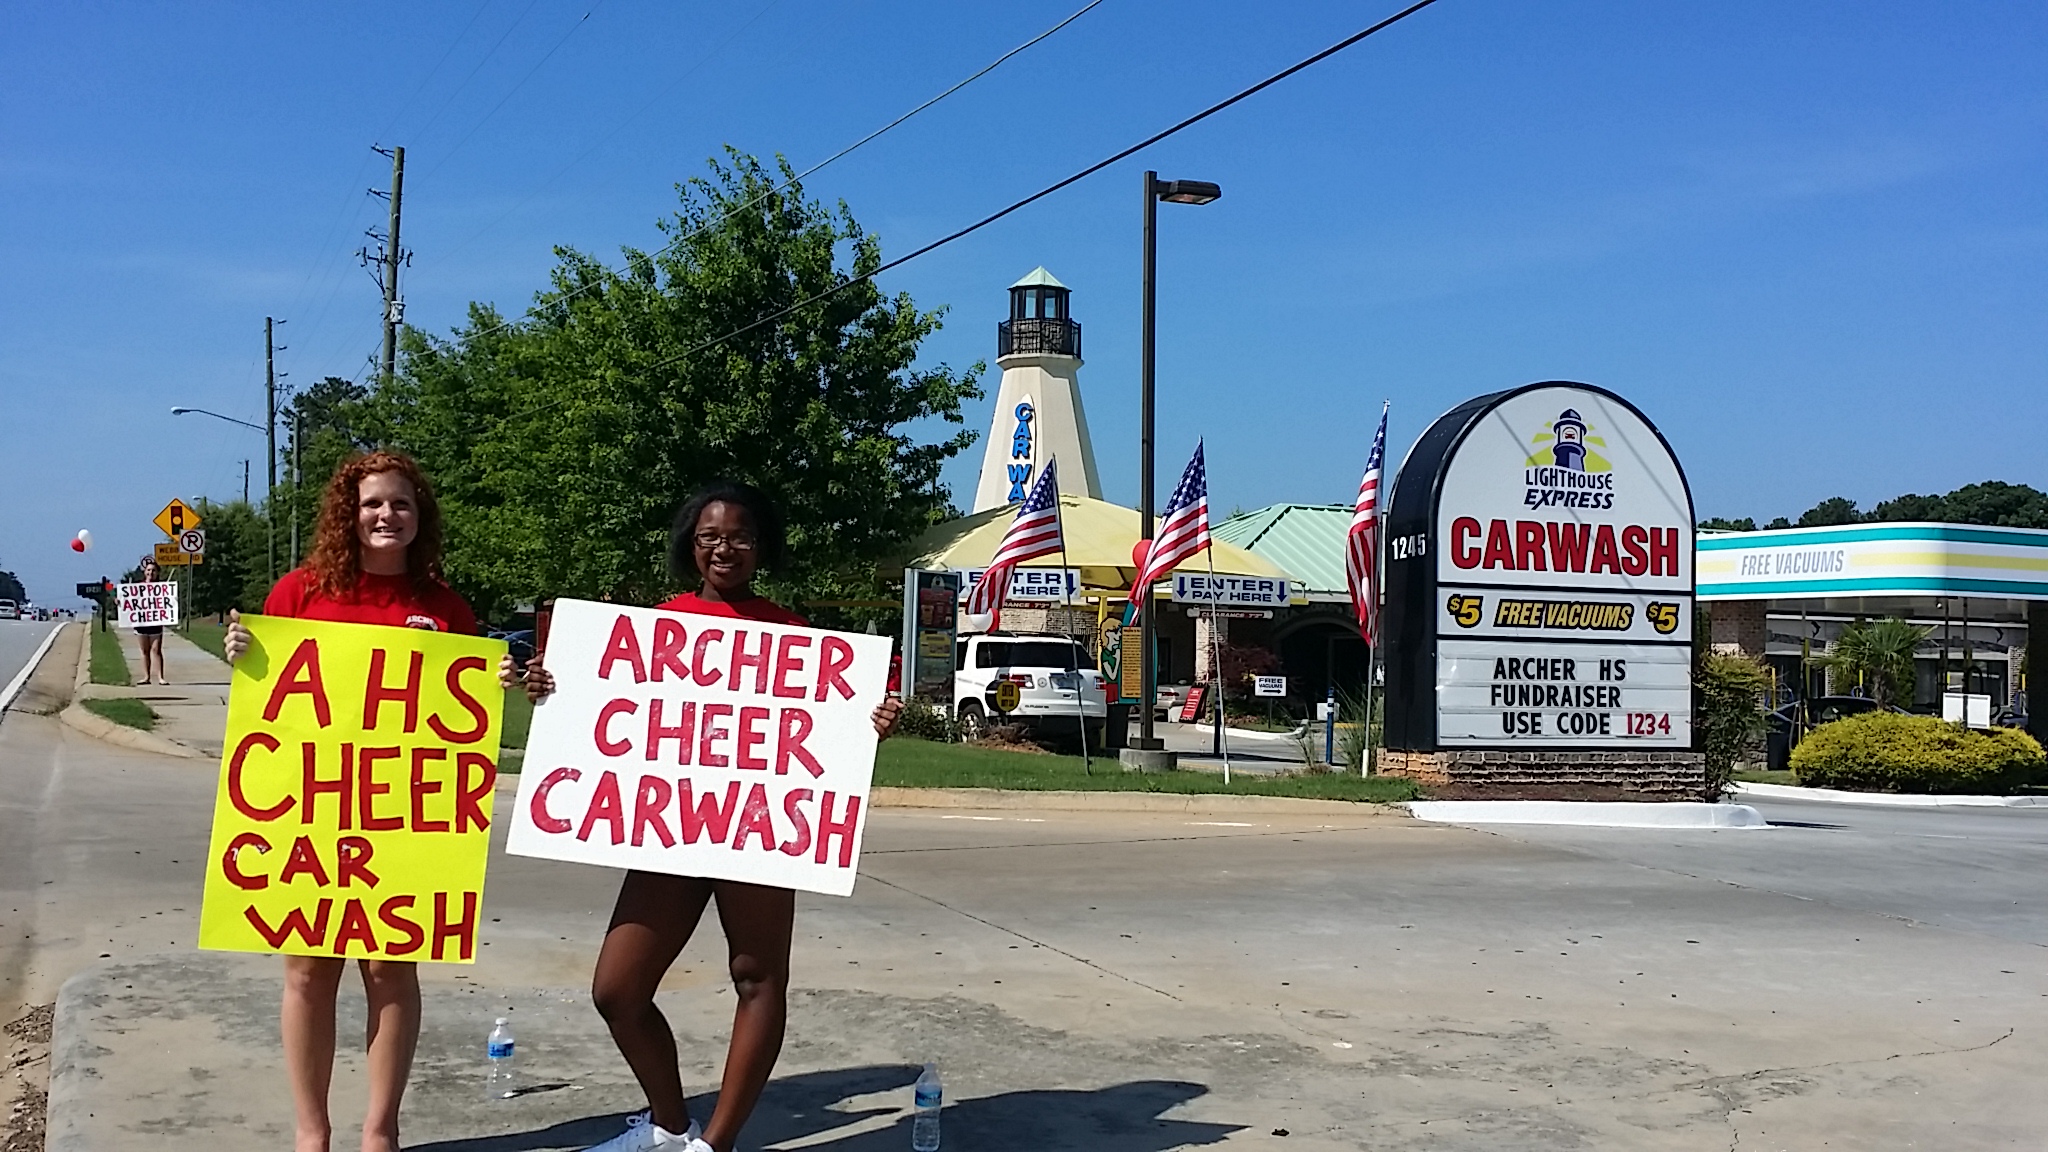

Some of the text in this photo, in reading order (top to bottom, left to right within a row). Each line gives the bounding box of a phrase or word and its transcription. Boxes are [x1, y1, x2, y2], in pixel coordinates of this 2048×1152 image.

[1007, 402, 1034, 504] CAR WA
[1525, 467, 1613, 490] LIGHTHOUSE
[1524, 488, 1615, 510] EXPRESS
[1392, 533, 1426, 560] 1245
[1450, 516, 1680, 577] CARWASH
[1741, 549, 1845, 576] FREE VACUUMS
[122, 583, 176, 598] SUPPORT
[969, 571, 1062, 584] ETER
[1012, 586, 1060, 595] HERE
[1190, 577, 1274, 592] ENTER
[122, 597, 174, 611] ARCHER
[1192, 591, 1272, 602] PAY HERE
[1448, 596, 1483, 627] $5
[1496, 601, 1633, 629] FREE VACUUMS
[1647, 604, 1679, 633] $5
[598, 613, 857, 703] ARCHER
[1493, 657, 1626, 681] ARCHER HS
[1490, 684, 1622, 708] FUNDRAISER
[1502, 712, 1671, 736] USE CODE 1234
[594, 697, 825, 779] CHEER
[228, 732, 498, 833] CHEER
[530, 767, 862, 868] CARWASH
[222, 832, 380, 890] CAR
[244, 891, 477, 960] WASH
